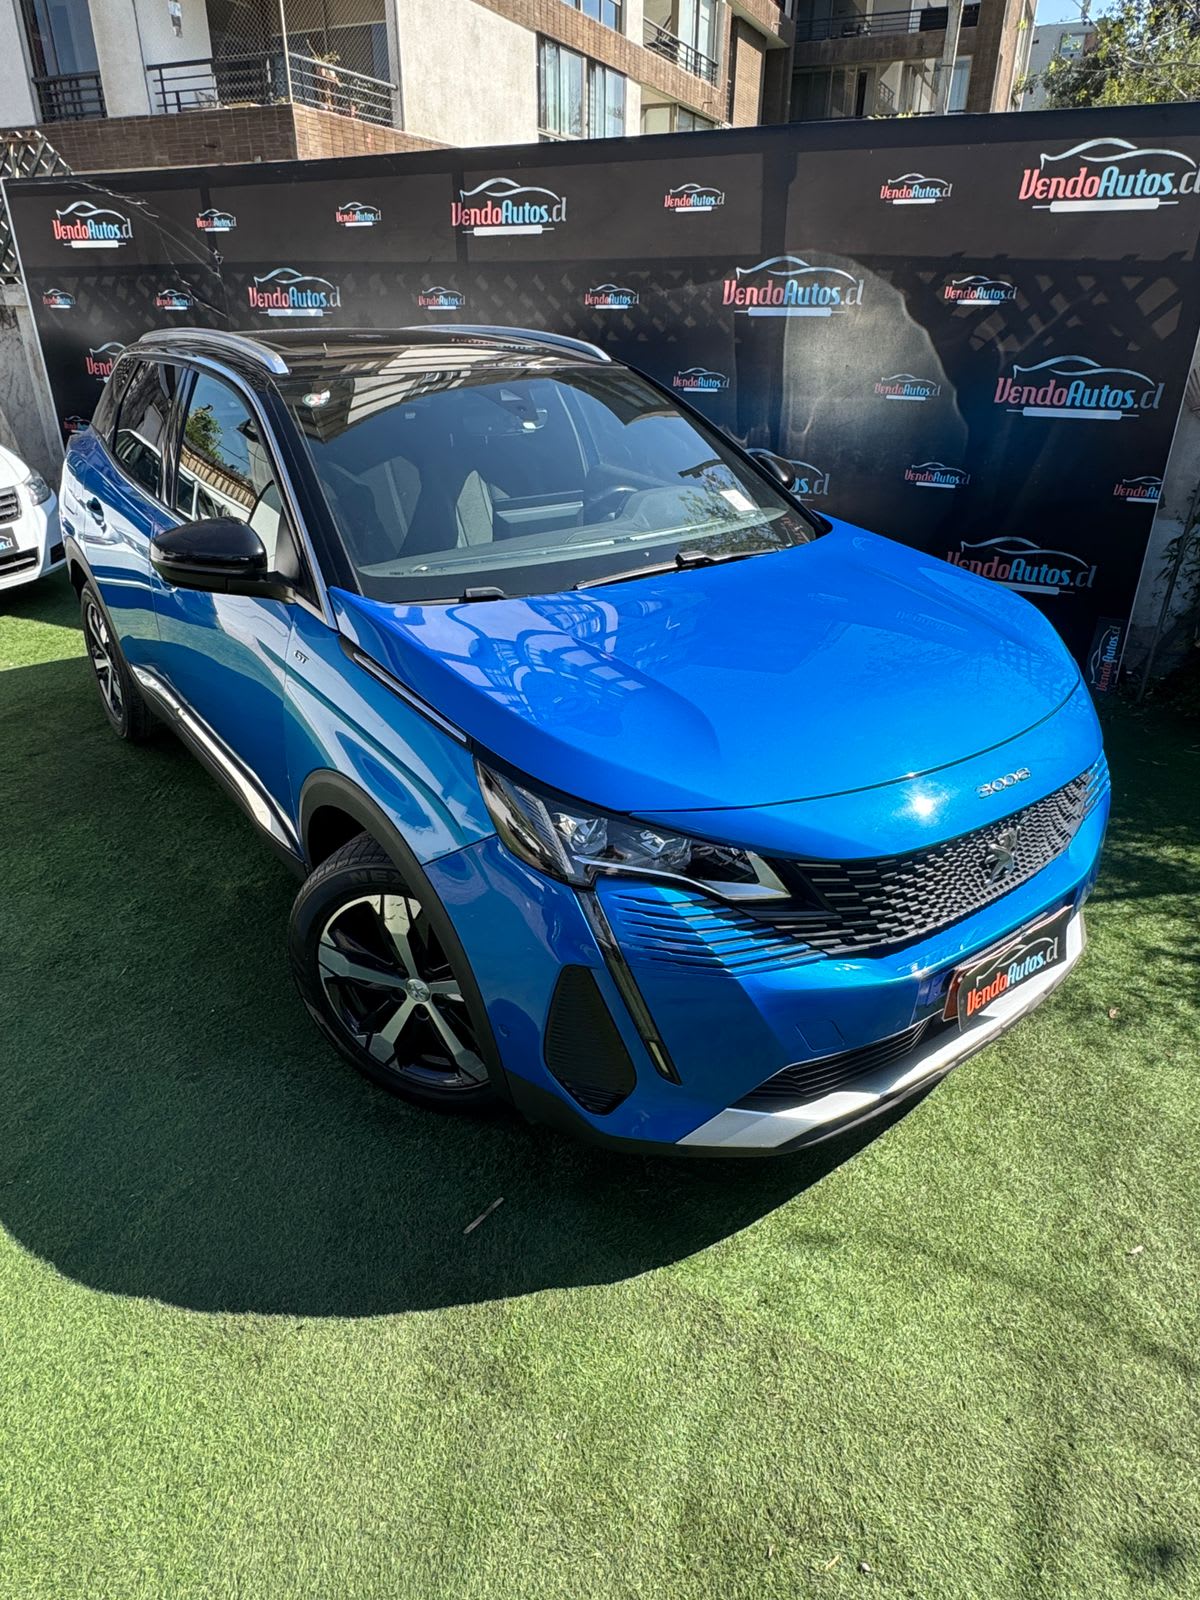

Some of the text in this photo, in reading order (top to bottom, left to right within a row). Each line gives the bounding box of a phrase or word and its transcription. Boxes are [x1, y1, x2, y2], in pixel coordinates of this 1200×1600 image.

[664, 192, 726, 208] VendoAutos.cl
[880, 183, 953, 201] VendoAutos.cl
[335, 210, 382, 223] VendoAutos.cl
[451, 197, 567, 227] VendoAutos.cl
[52, 217, 134, 241] VendoAutos.cl
[248, 286, 342, 308] VendoAutos.cl
[418, 293, 466, 307] VendoAutos.cl
[584, 292, 640, 306] VendoAutos.cl
[722, 278, 863, 307] VendoAutos.cl
[943, 285, 1018, 301] VendoAutos.cl
[672, 375, 730, 389] VendoAutos.cl
[874, 382, 942, 397] VendoAutos.cl
[993, 376, 1165, 410] VendoAutos.cl
[904, 467, 971, 486] VendoAutos.cl
[1095, 625, 1122, 692] VendoAutos.cl
[975, 767, 1031, 799] 3008
[966, 936, 1060, 1016] VendoAutos.cl
